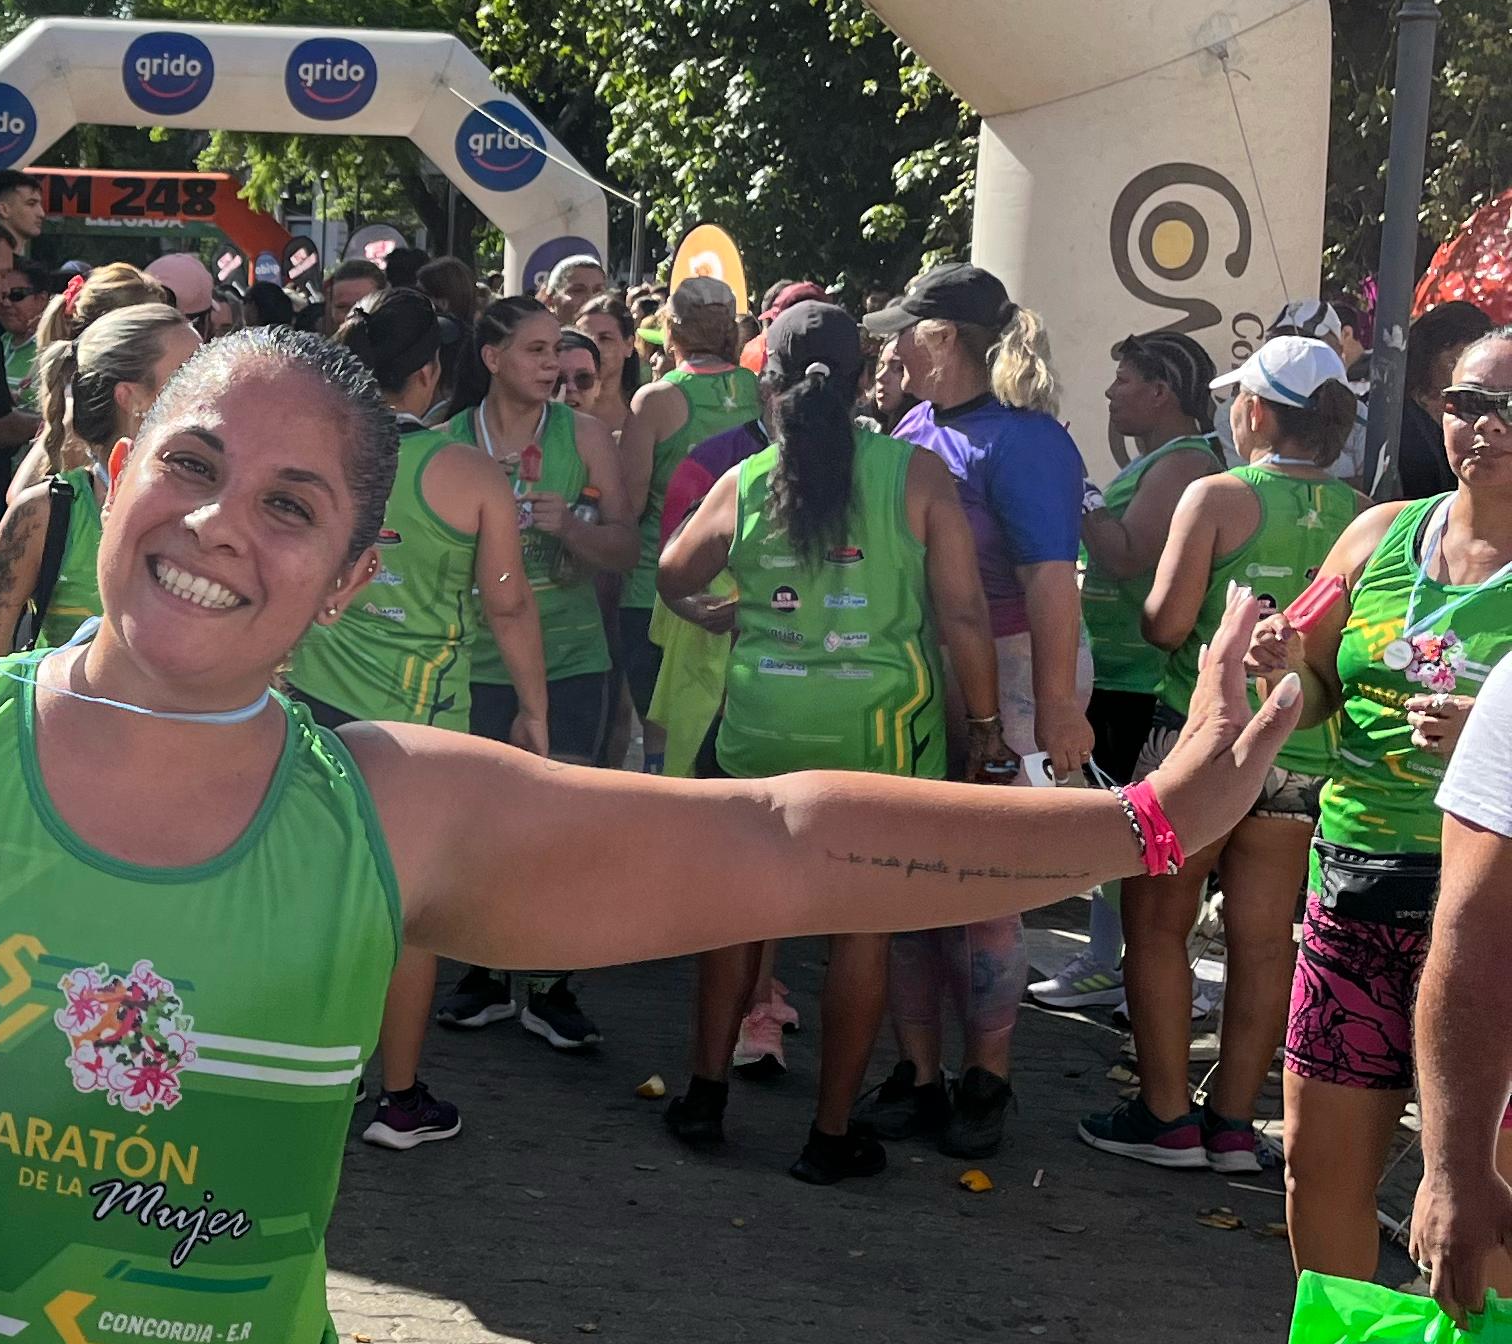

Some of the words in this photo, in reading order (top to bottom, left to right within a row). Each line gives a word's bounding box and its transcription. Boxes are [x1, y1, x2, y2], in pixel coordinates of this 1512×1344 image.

[135, 53, 203, 82] grido
[298, 58, 365, 87] grido
[468, 127, 536, 156] grido
[110, 176, 217, 217] 248
[18, 1166, 49, 1191] DE
[56, 1173, 83, 1198] LA
[90, 1178, 252, 1268] Mujer
[97, 1311, 214, 1343] CONCORDIA
